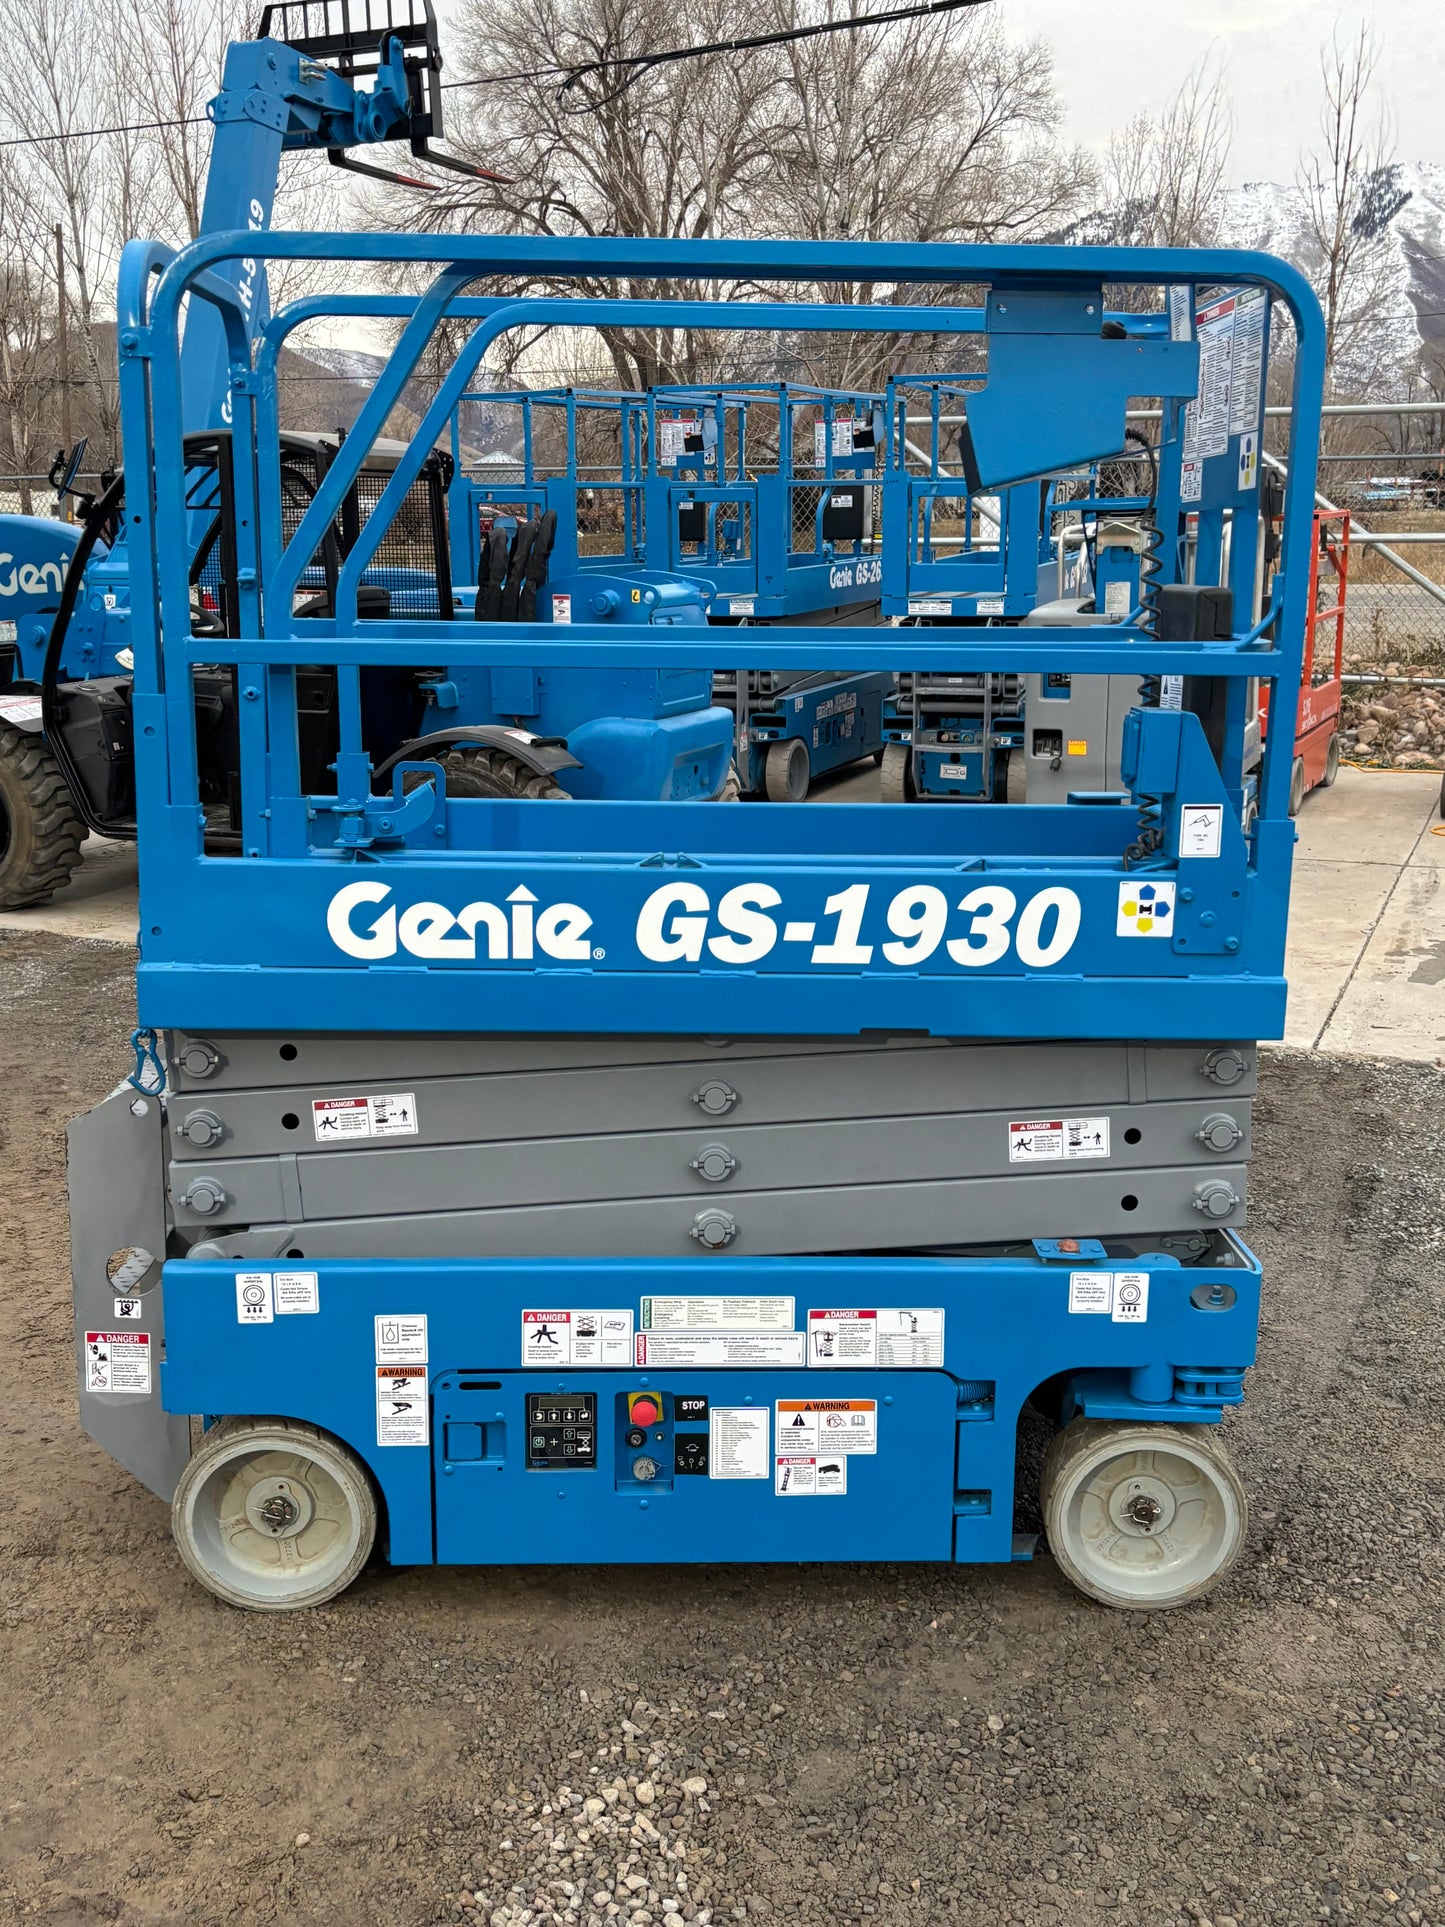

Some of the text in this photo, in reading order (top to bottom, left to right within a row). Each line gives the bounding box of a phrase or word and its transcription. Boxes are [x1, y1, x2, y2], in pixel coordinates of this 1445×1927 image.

[0, 552, 84, 597] Geni
[829, 560, 882, 589] Genie GS-26
[636, 882, 1081, 967] GS-1930
[330, 1100, 355, 1108] DANGER
[537, 1313, 567, 1322] DANGER
[831, 1311, 859, 1319] DANGER
[106, 1334, 139, 1343] DANGER
[388, 1368, 423, 1376] WARNING
[682, 1400, 706, 1410] STOP
[813, 1402, 850, 1410] WARNING
